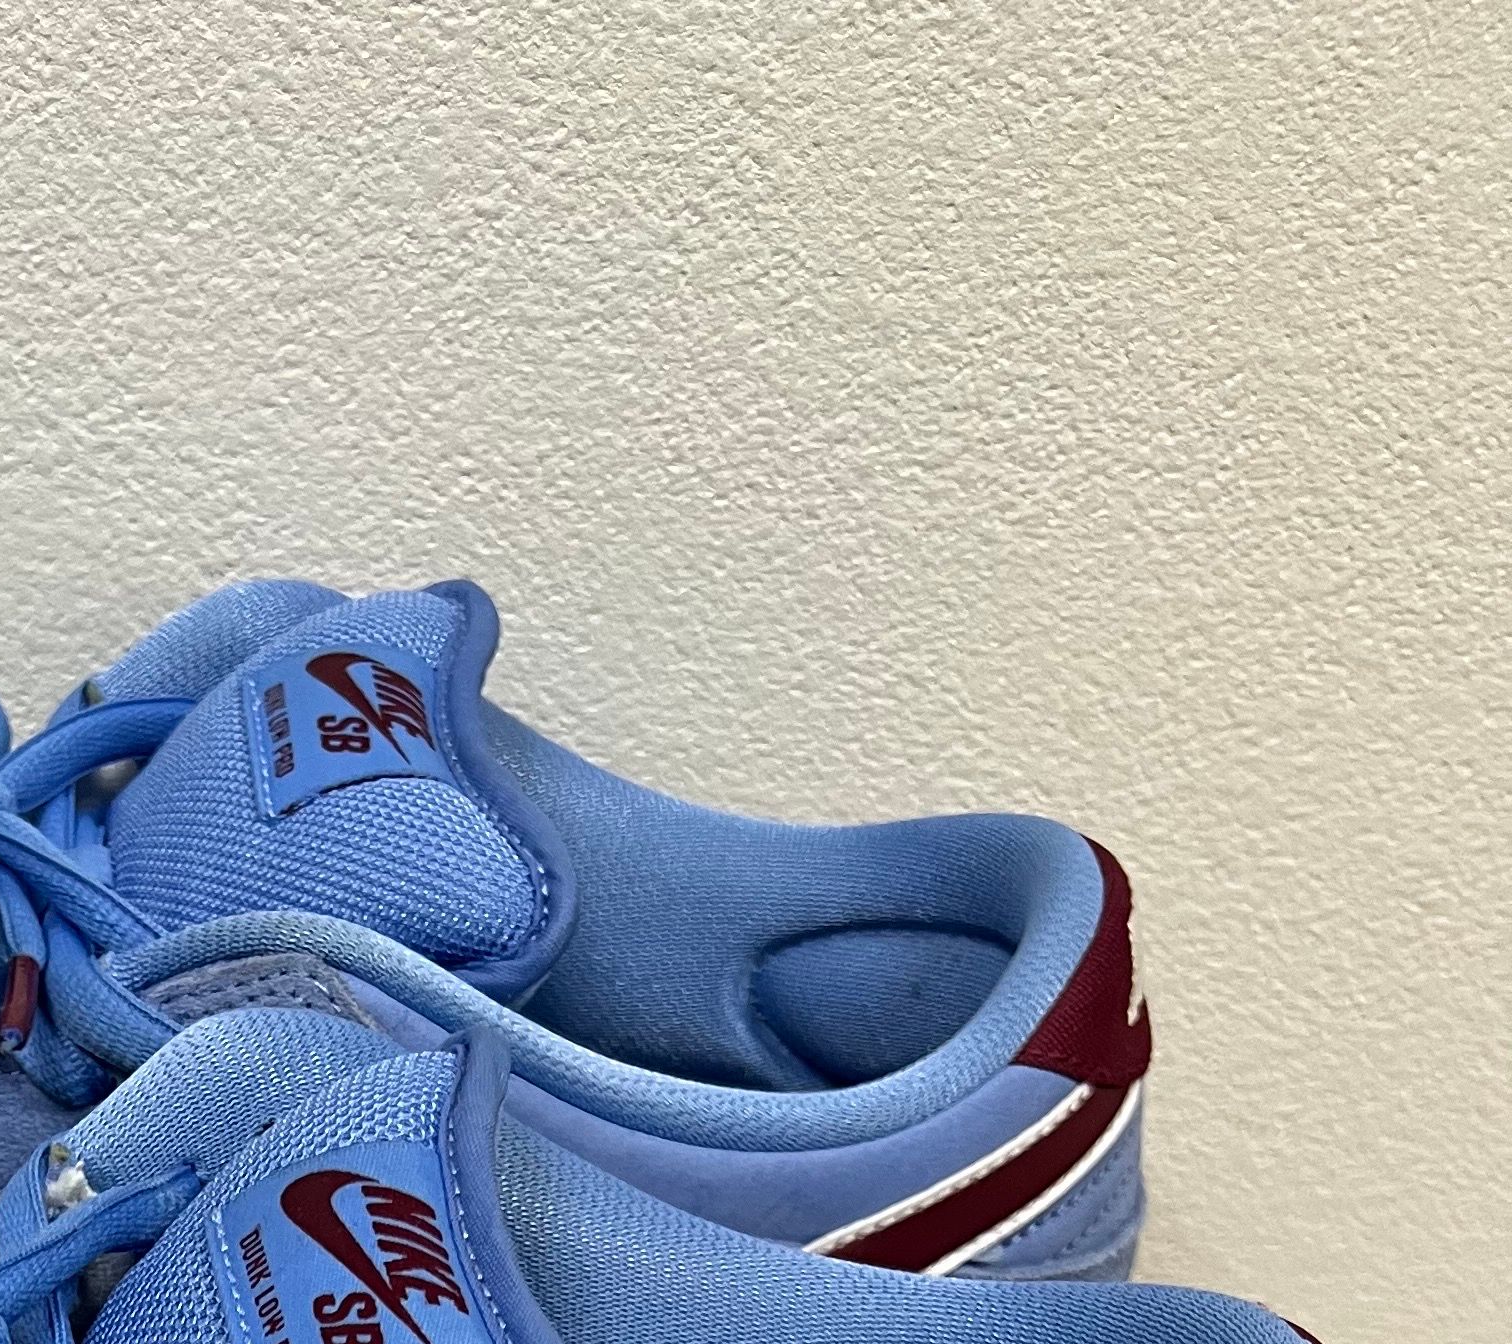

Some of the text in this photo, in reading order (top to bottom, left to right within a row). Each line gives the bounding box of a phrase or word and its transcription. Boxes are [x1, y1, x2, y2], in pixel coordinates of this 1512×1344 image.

[316, 715, 371, 753] SB
[370, 664, 436, 752] NIKE
[239, 1223, 272, 1290] DUNK
[360, 1184, 470, 1316] NIKE
[254, 1285, 285, 1337] LOW
